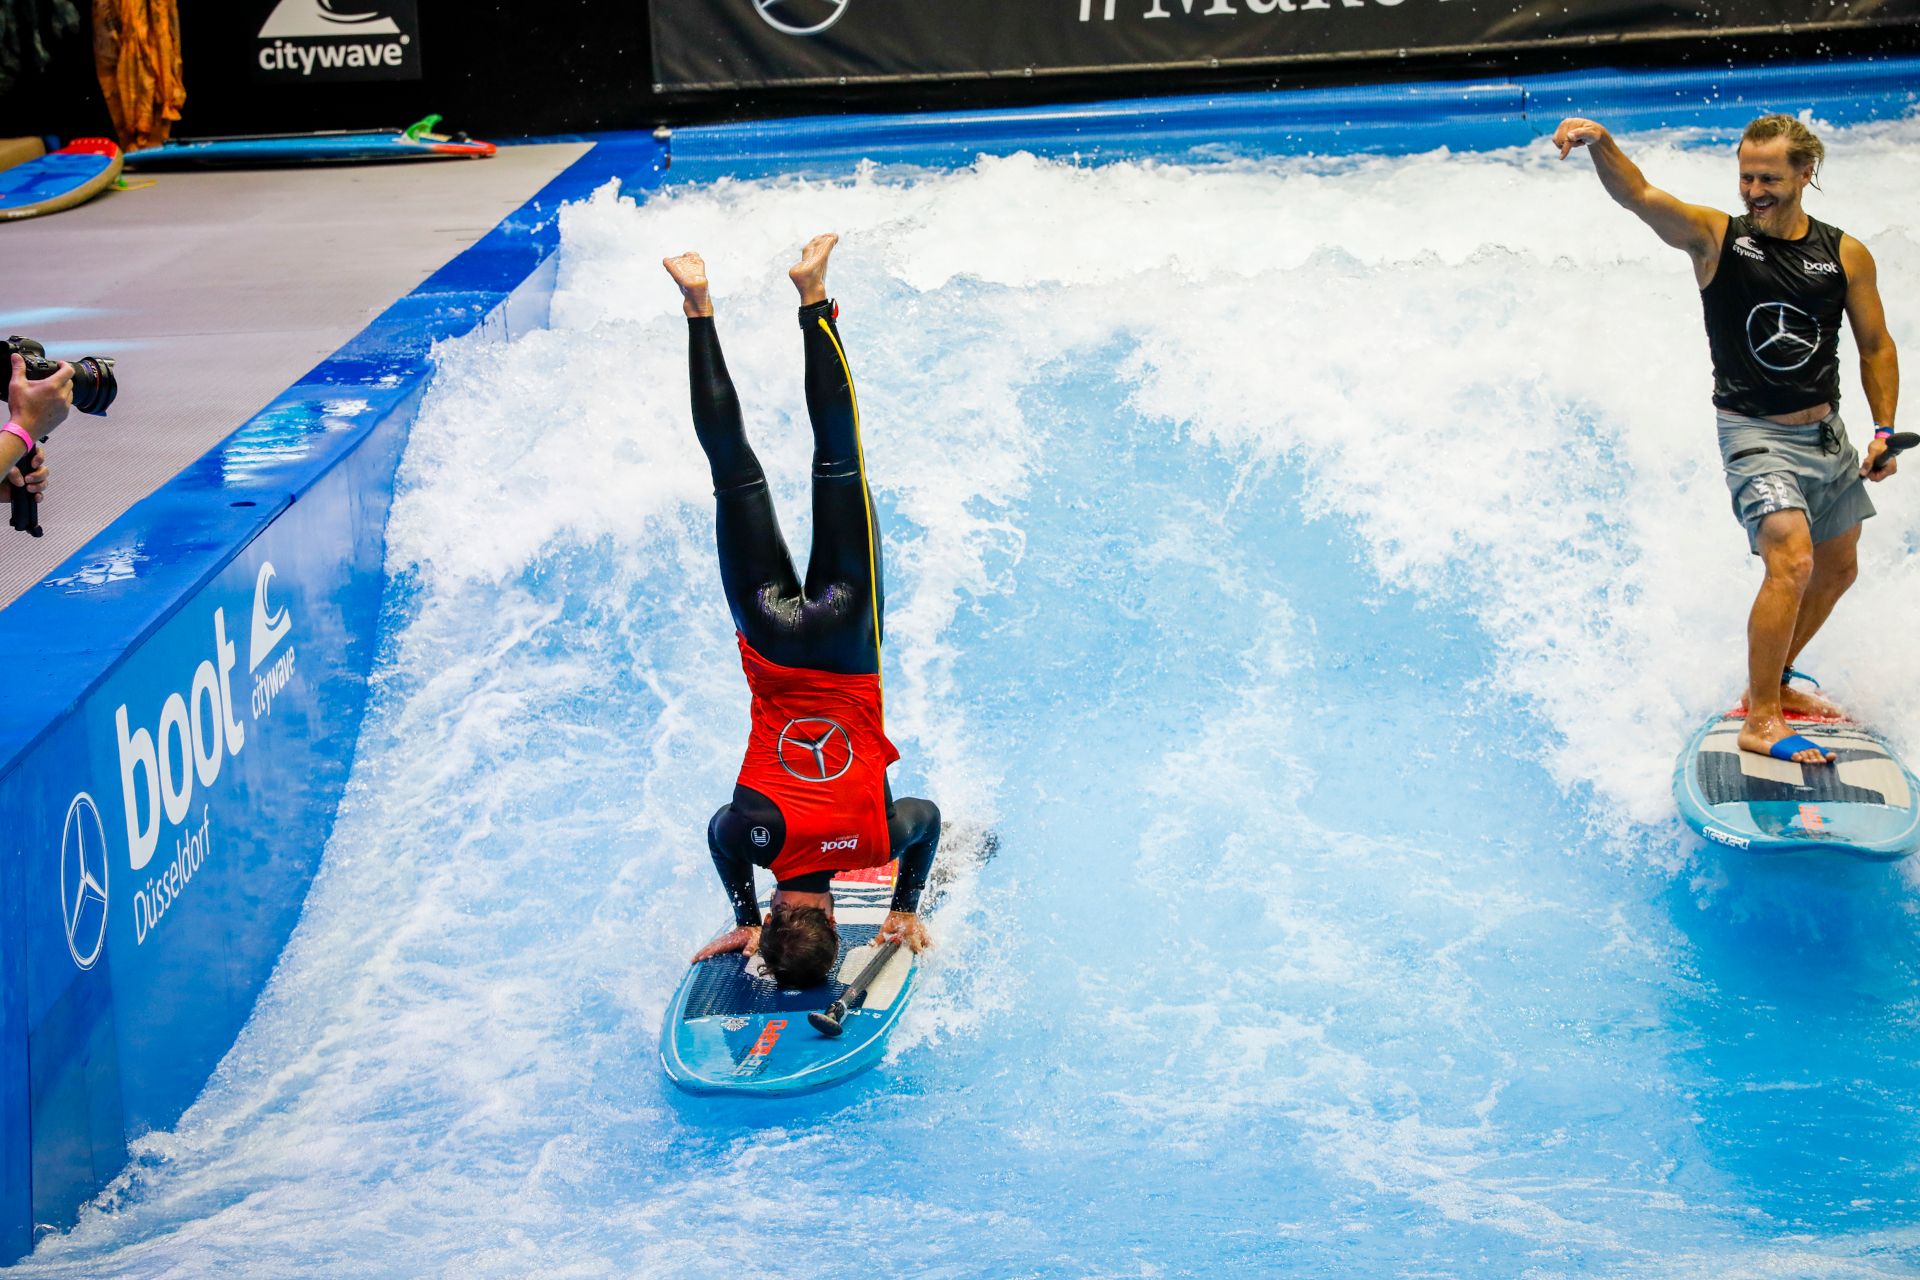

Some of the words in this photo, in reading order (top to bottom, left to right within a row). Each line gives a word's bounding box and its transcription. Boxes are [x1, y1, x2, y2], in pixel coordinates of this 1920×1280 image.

[1803, 259, 1839, 274] boot
[251, 645, 296, 721] citywave
[115, 606, 245, 870] boot
[133, 804, 210, 945] Düsseldorf
[820, 839, 858, 853] boot
